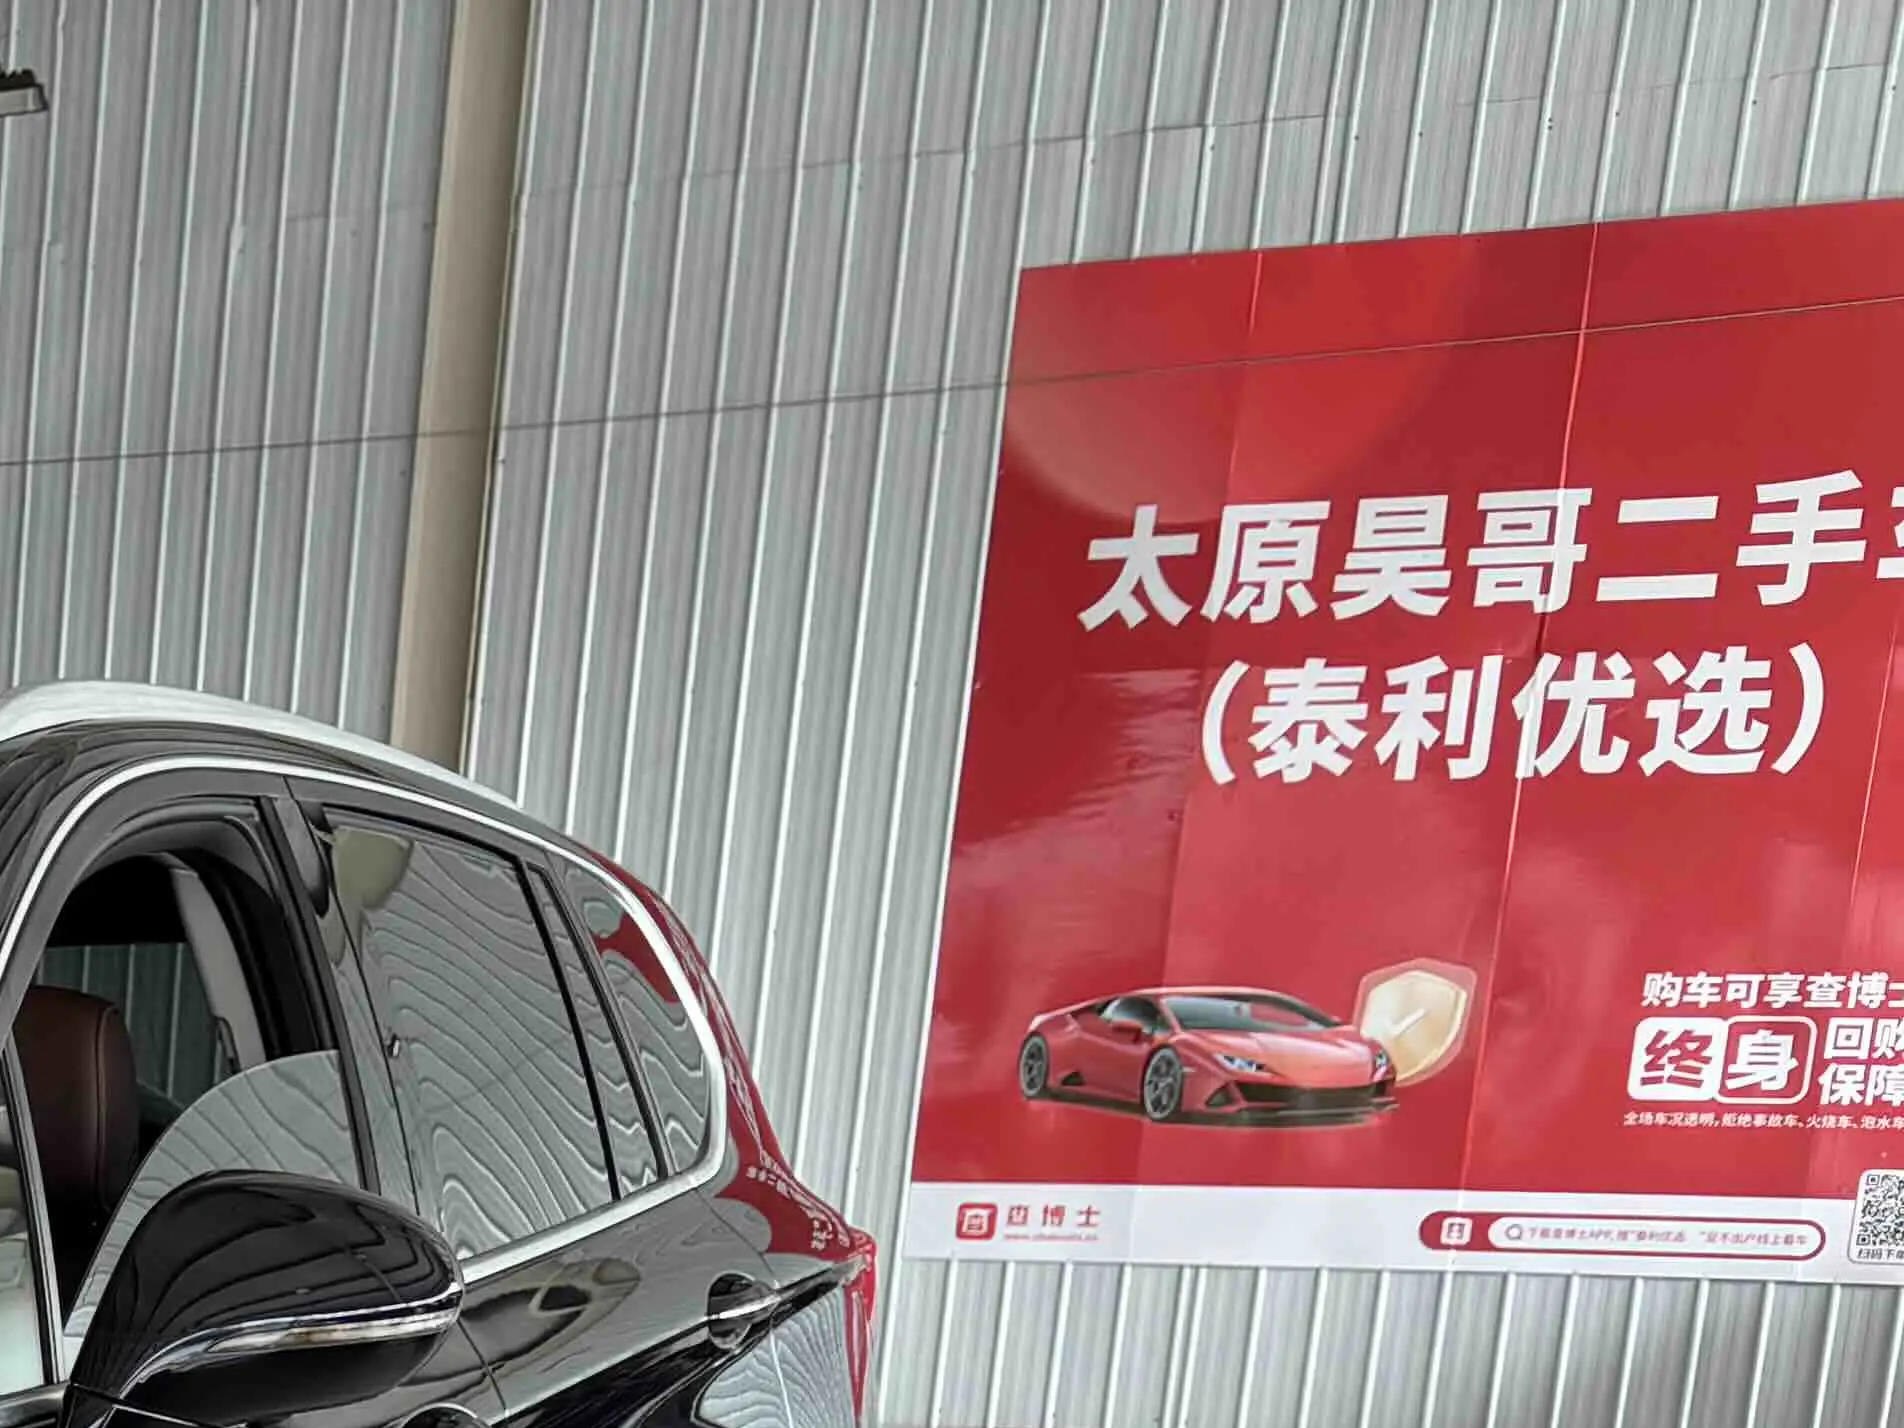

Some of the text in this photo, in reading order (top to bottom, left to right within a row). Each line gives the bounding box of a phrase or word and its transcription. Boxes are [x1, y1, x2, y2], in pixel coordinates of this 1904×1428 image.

[1077, 470, 1904, 631] 太原昊哥二手
[1200, 643, 1827, 786] (泰利优选)
[1639, 1028, 1800, 1091] 终身
